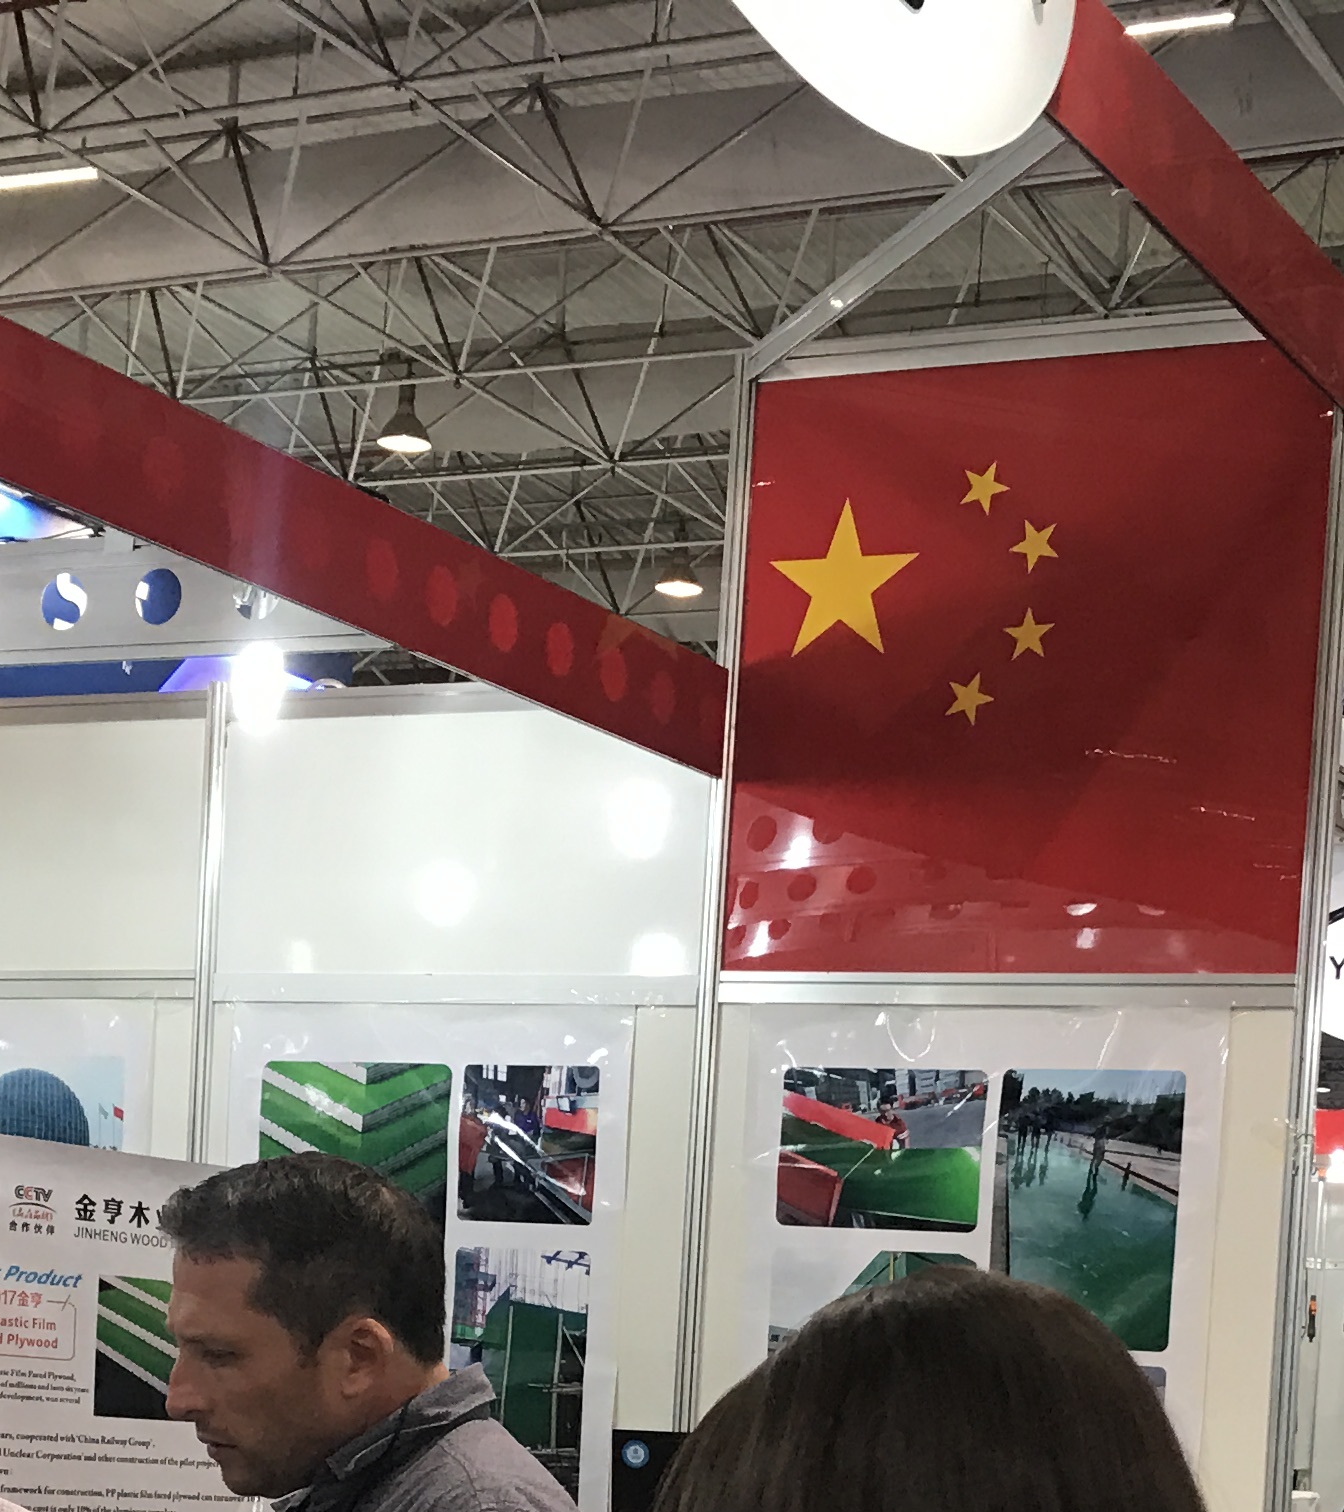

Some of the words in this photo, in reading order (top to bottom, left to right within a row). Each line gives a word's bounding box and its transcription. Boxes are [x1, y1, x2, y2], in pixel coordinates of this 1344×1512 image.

[14, 1185, 53, 1202] CCTV
[75, 1194, 166, 1230] 金亨木
[74, 1226, 128, 1244] JINHENG
[130, 1232, 168, 1249] WOOD
[3, 1265, 83, 1288] Product
[32, 1317, 57, 1331] Film
[7, 1333, 58, 1349] Plywood
[16, 1433, 59, 1444] cooperated
